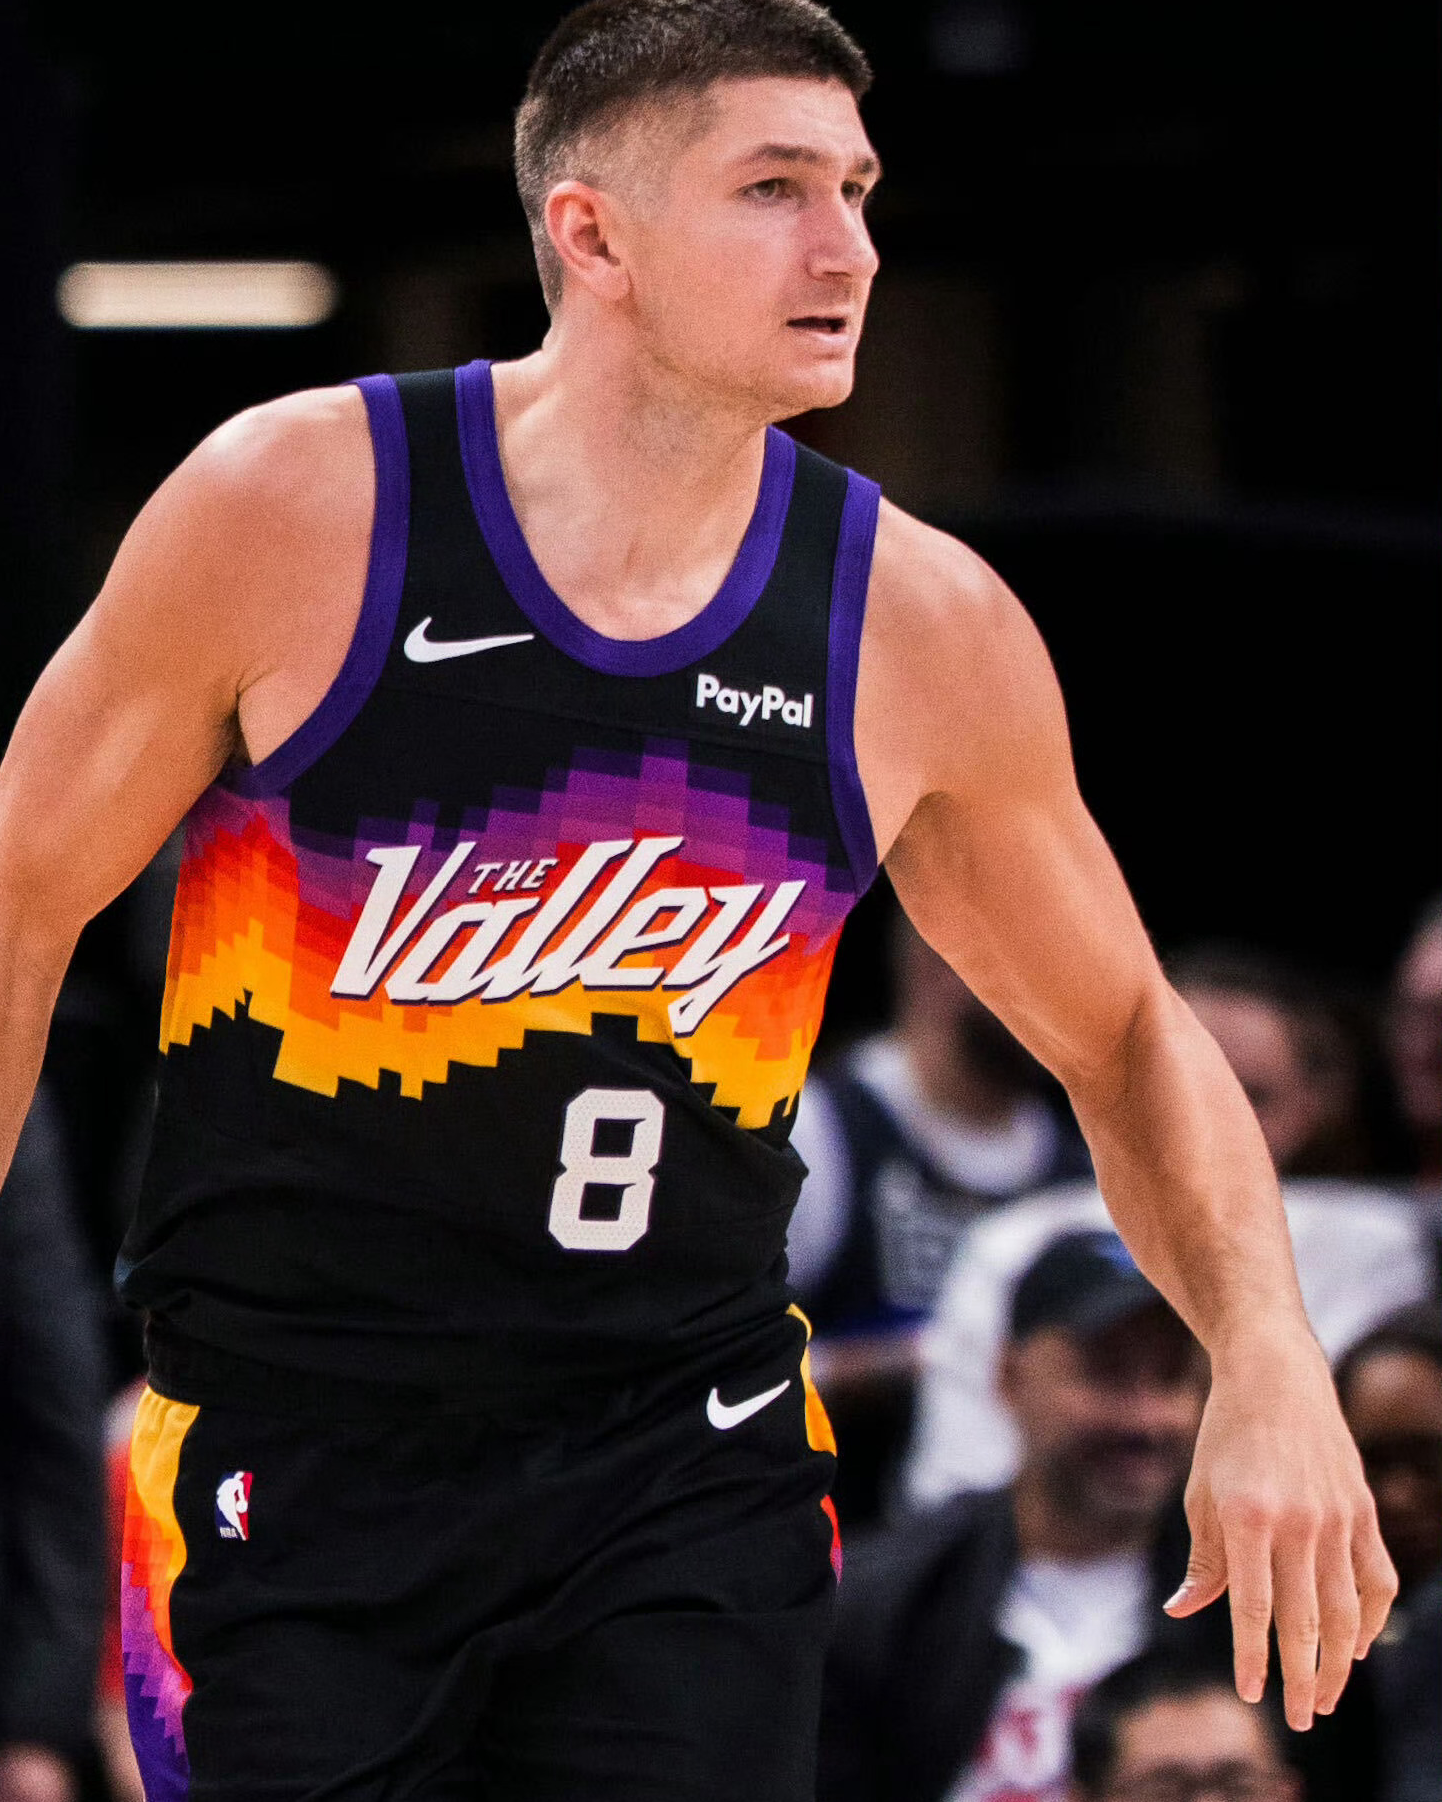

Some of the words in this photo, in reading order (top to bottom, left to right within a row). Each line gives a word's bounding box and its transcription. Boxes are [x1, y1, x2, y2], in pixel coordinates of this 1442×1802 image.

[696, 673, 813, 729] PayPal
[468, 857, 559, 895] THE
[329, 835, 808, 1037] Valley
[547, 1087, 666, 1252] 8
